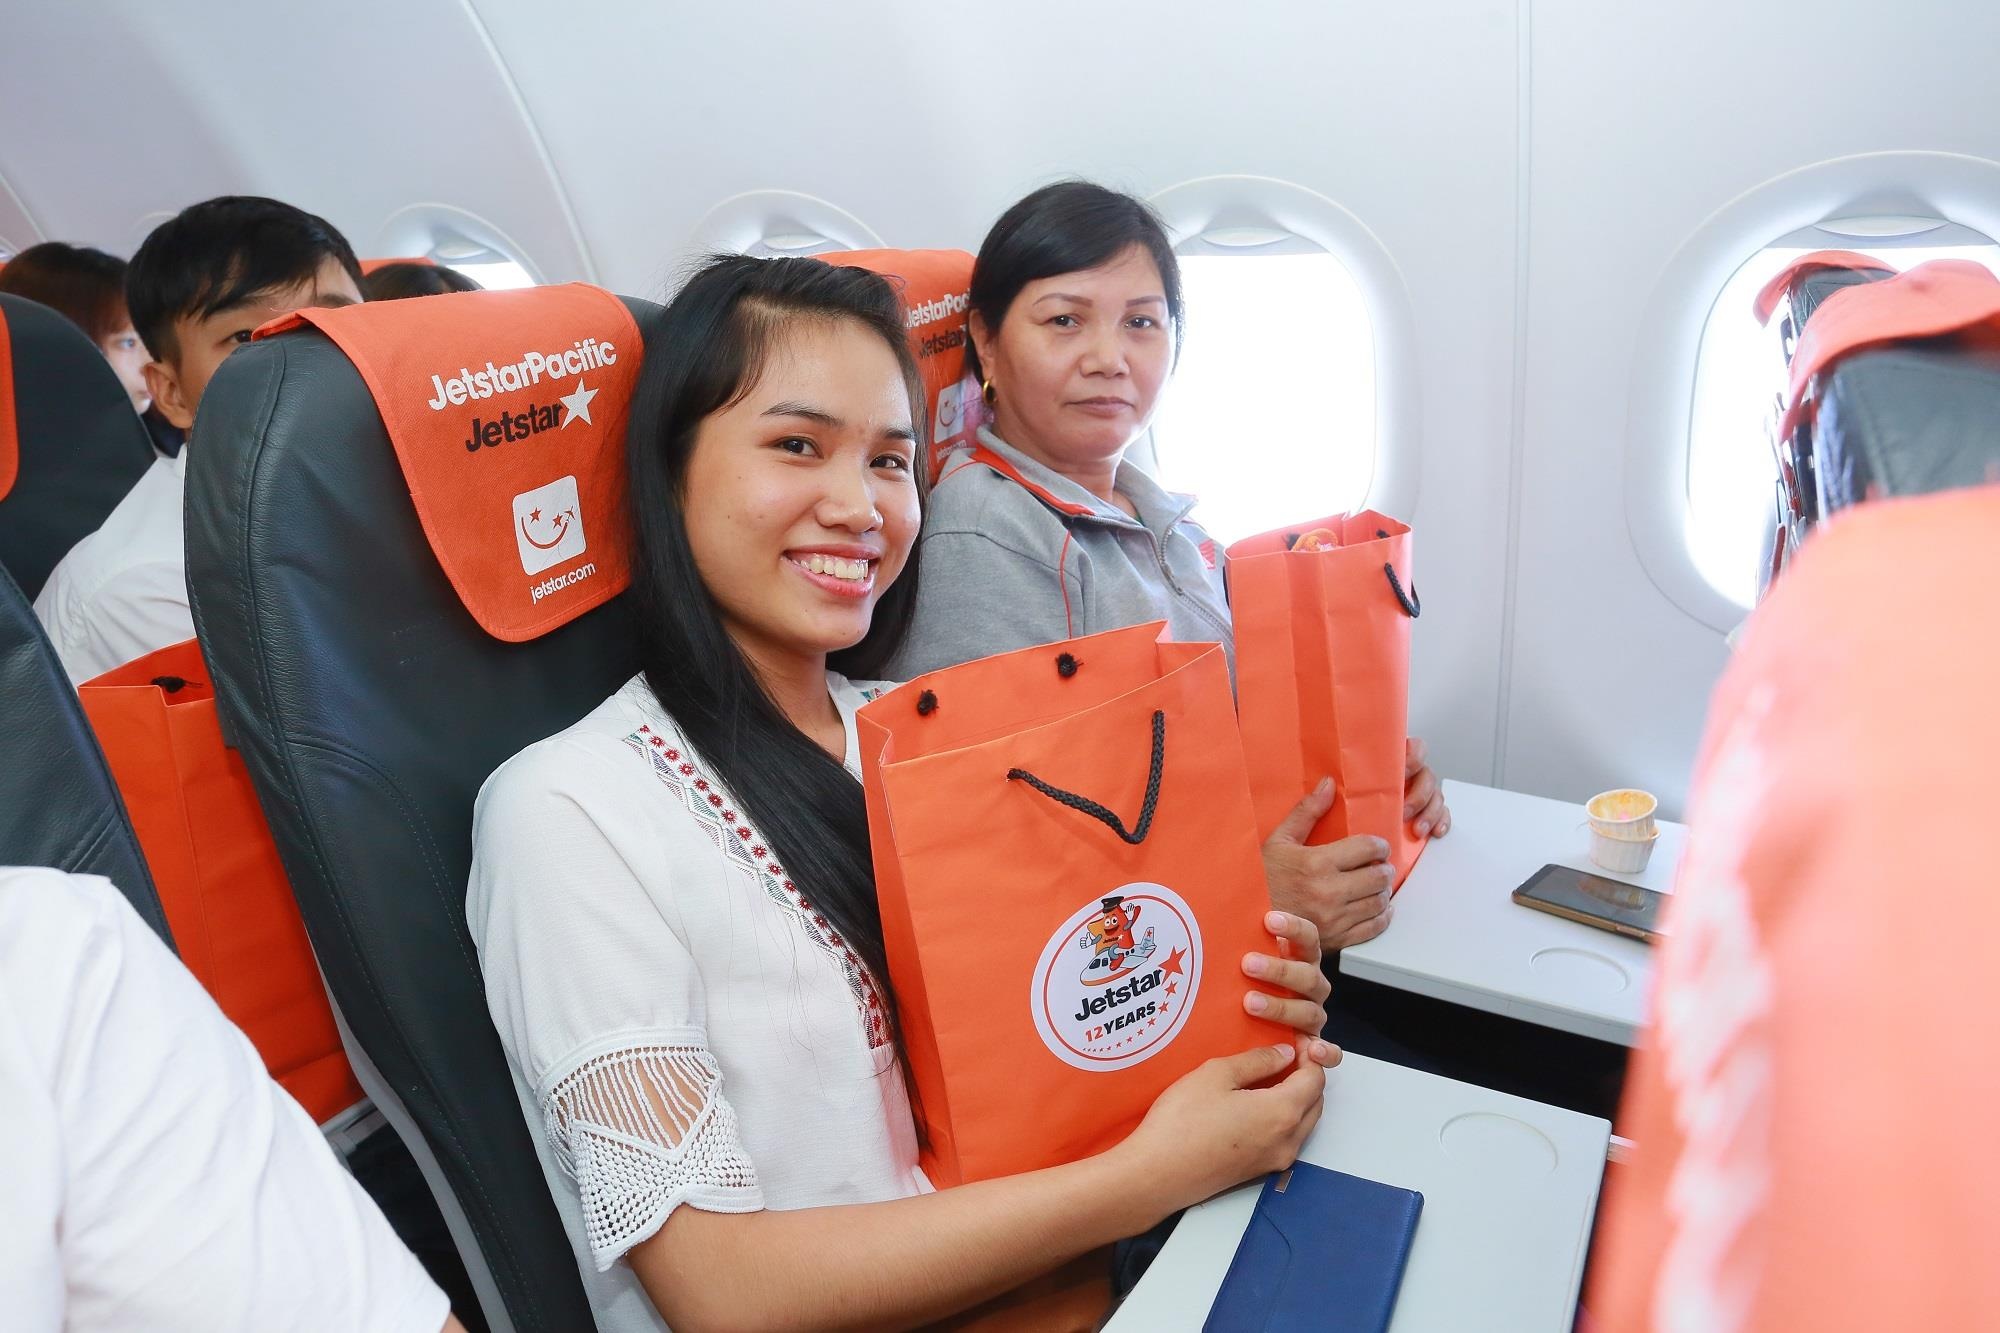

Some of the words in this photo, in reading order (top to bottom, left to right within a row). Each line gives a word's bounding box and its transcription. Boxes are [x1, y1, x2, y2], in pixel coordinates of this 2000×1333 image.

[428, 338, 617, 410] JetstarPacific
[465, 403, 563, 452] Jetstar
[529, 561, 596, 605] jetstar.com
[1074, 968, 1163, 1021] Jetstar
